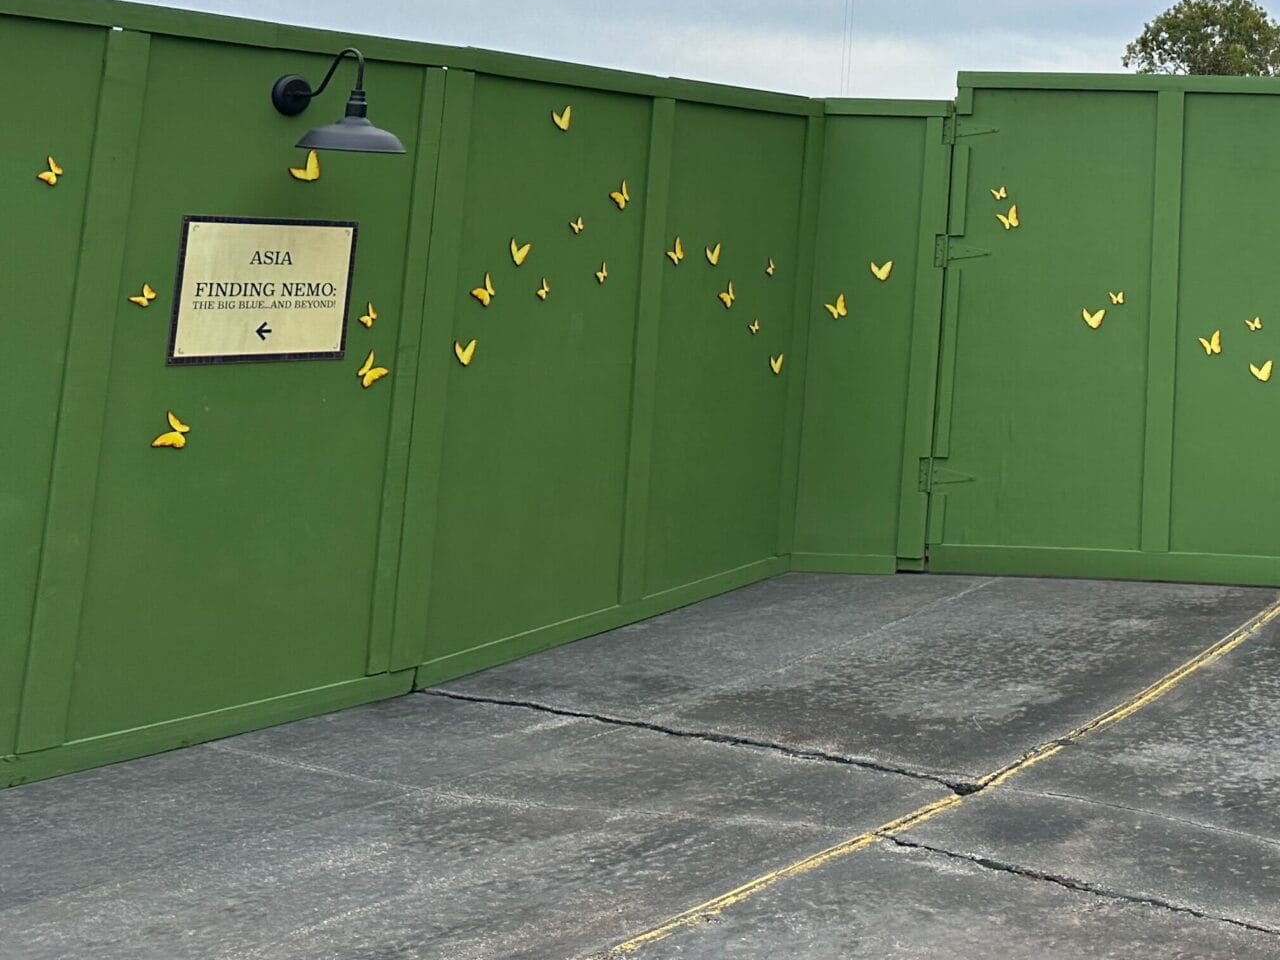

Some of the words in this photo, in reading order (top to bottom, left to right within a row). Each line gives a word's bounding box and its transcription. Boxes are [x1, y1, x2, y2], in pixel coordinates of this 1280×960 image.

[249, 250, 293, 266] ASIA
[194, 282, 275, 297] FINDING
[280, 282, 337, 297] NEMO:
[192, 300, 215, 310] THE
[217, 300, 236, 310] BIG
[294, 299, 337, 309] BEYOND!
